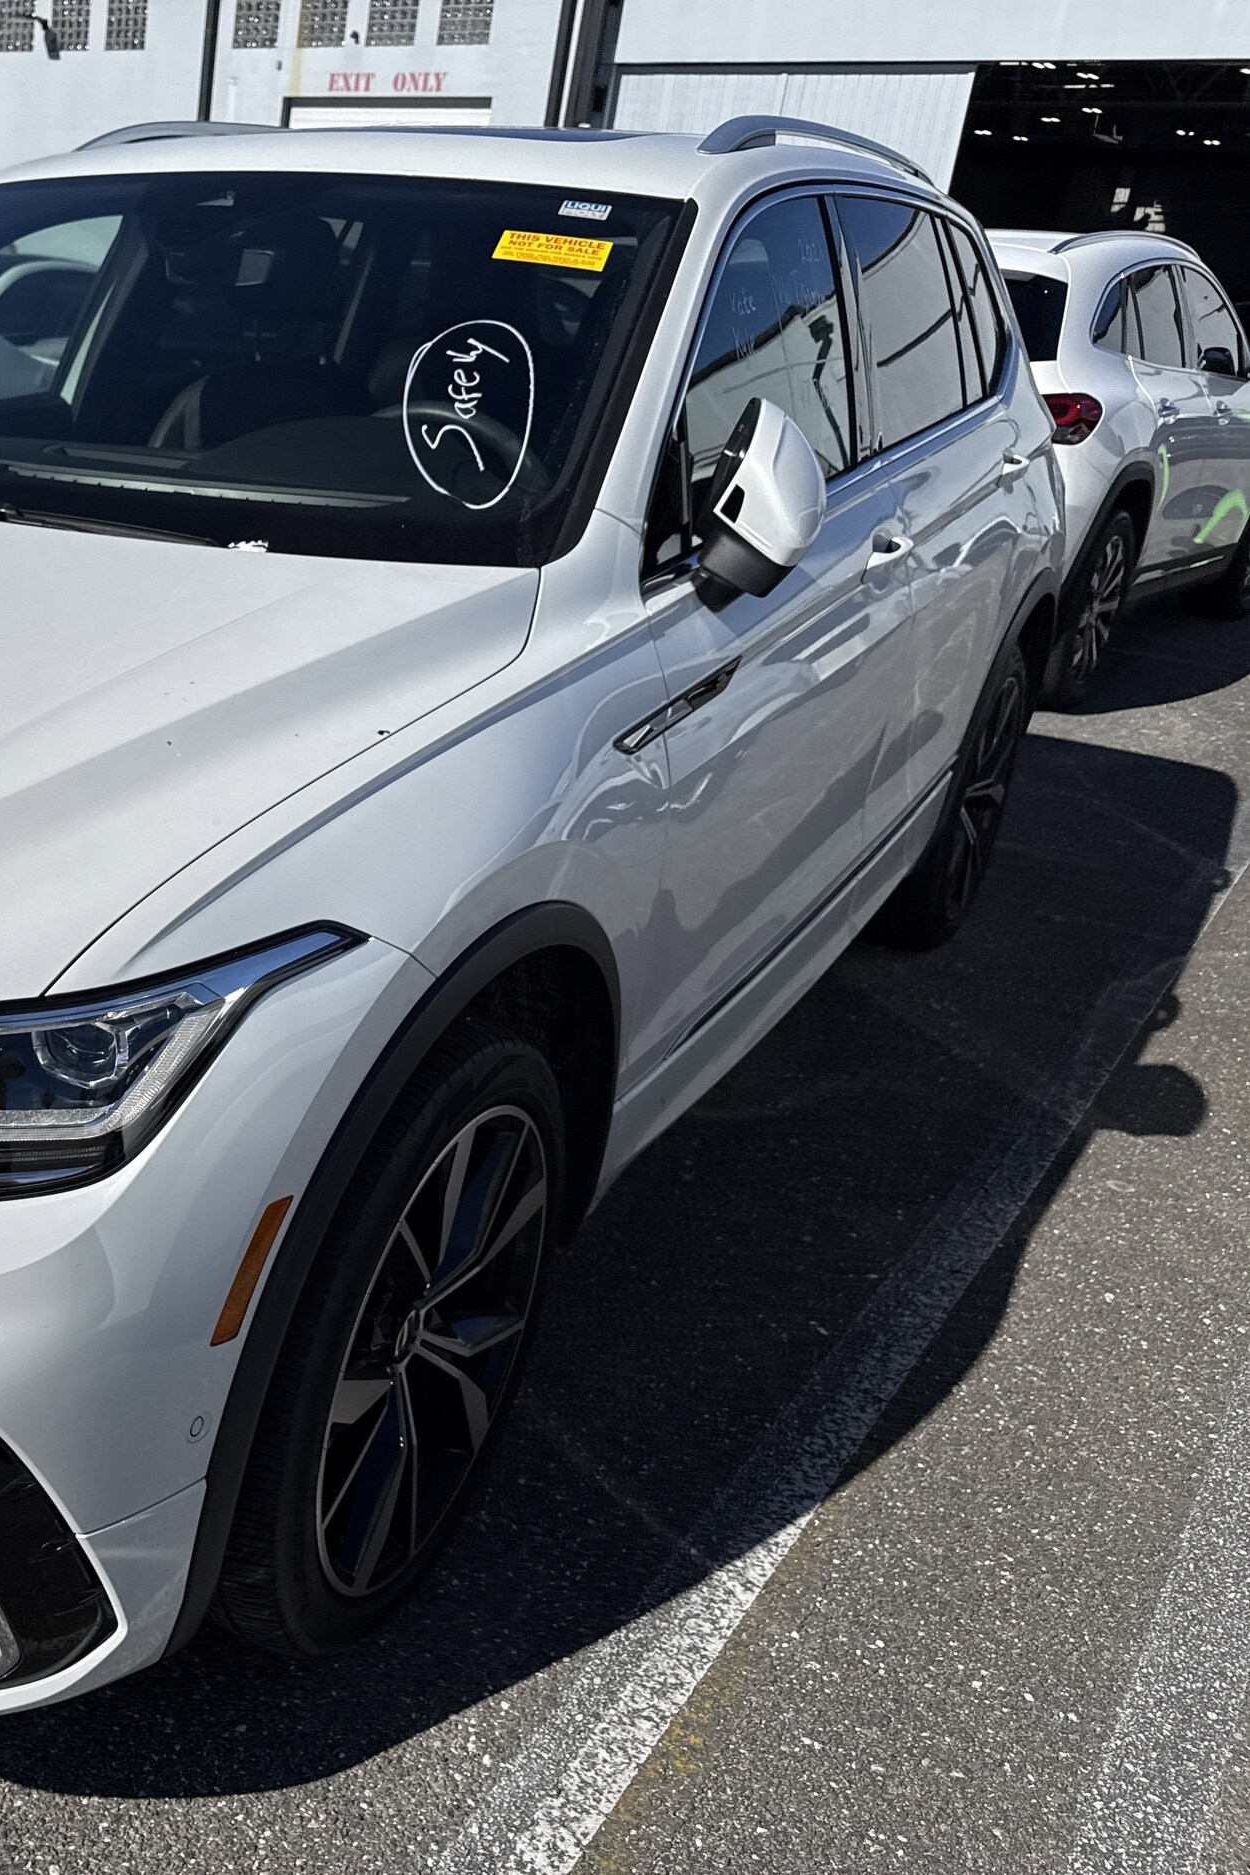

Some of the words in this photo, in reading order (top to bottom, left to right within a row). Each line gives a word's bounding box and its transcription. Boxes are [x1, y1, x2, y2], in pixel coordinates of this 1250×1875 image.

[327, 71, 376, 92] EXIT
[391, 71, 448, 92] ONLY
[566, 200, 608, 212] LIQUI
[509, 232, 541, 242] THIS
[545, 235, 607, 250] VEHICLE
[537, 243, 563, 251] FOR
[567, 246, 601, 255] SALE
